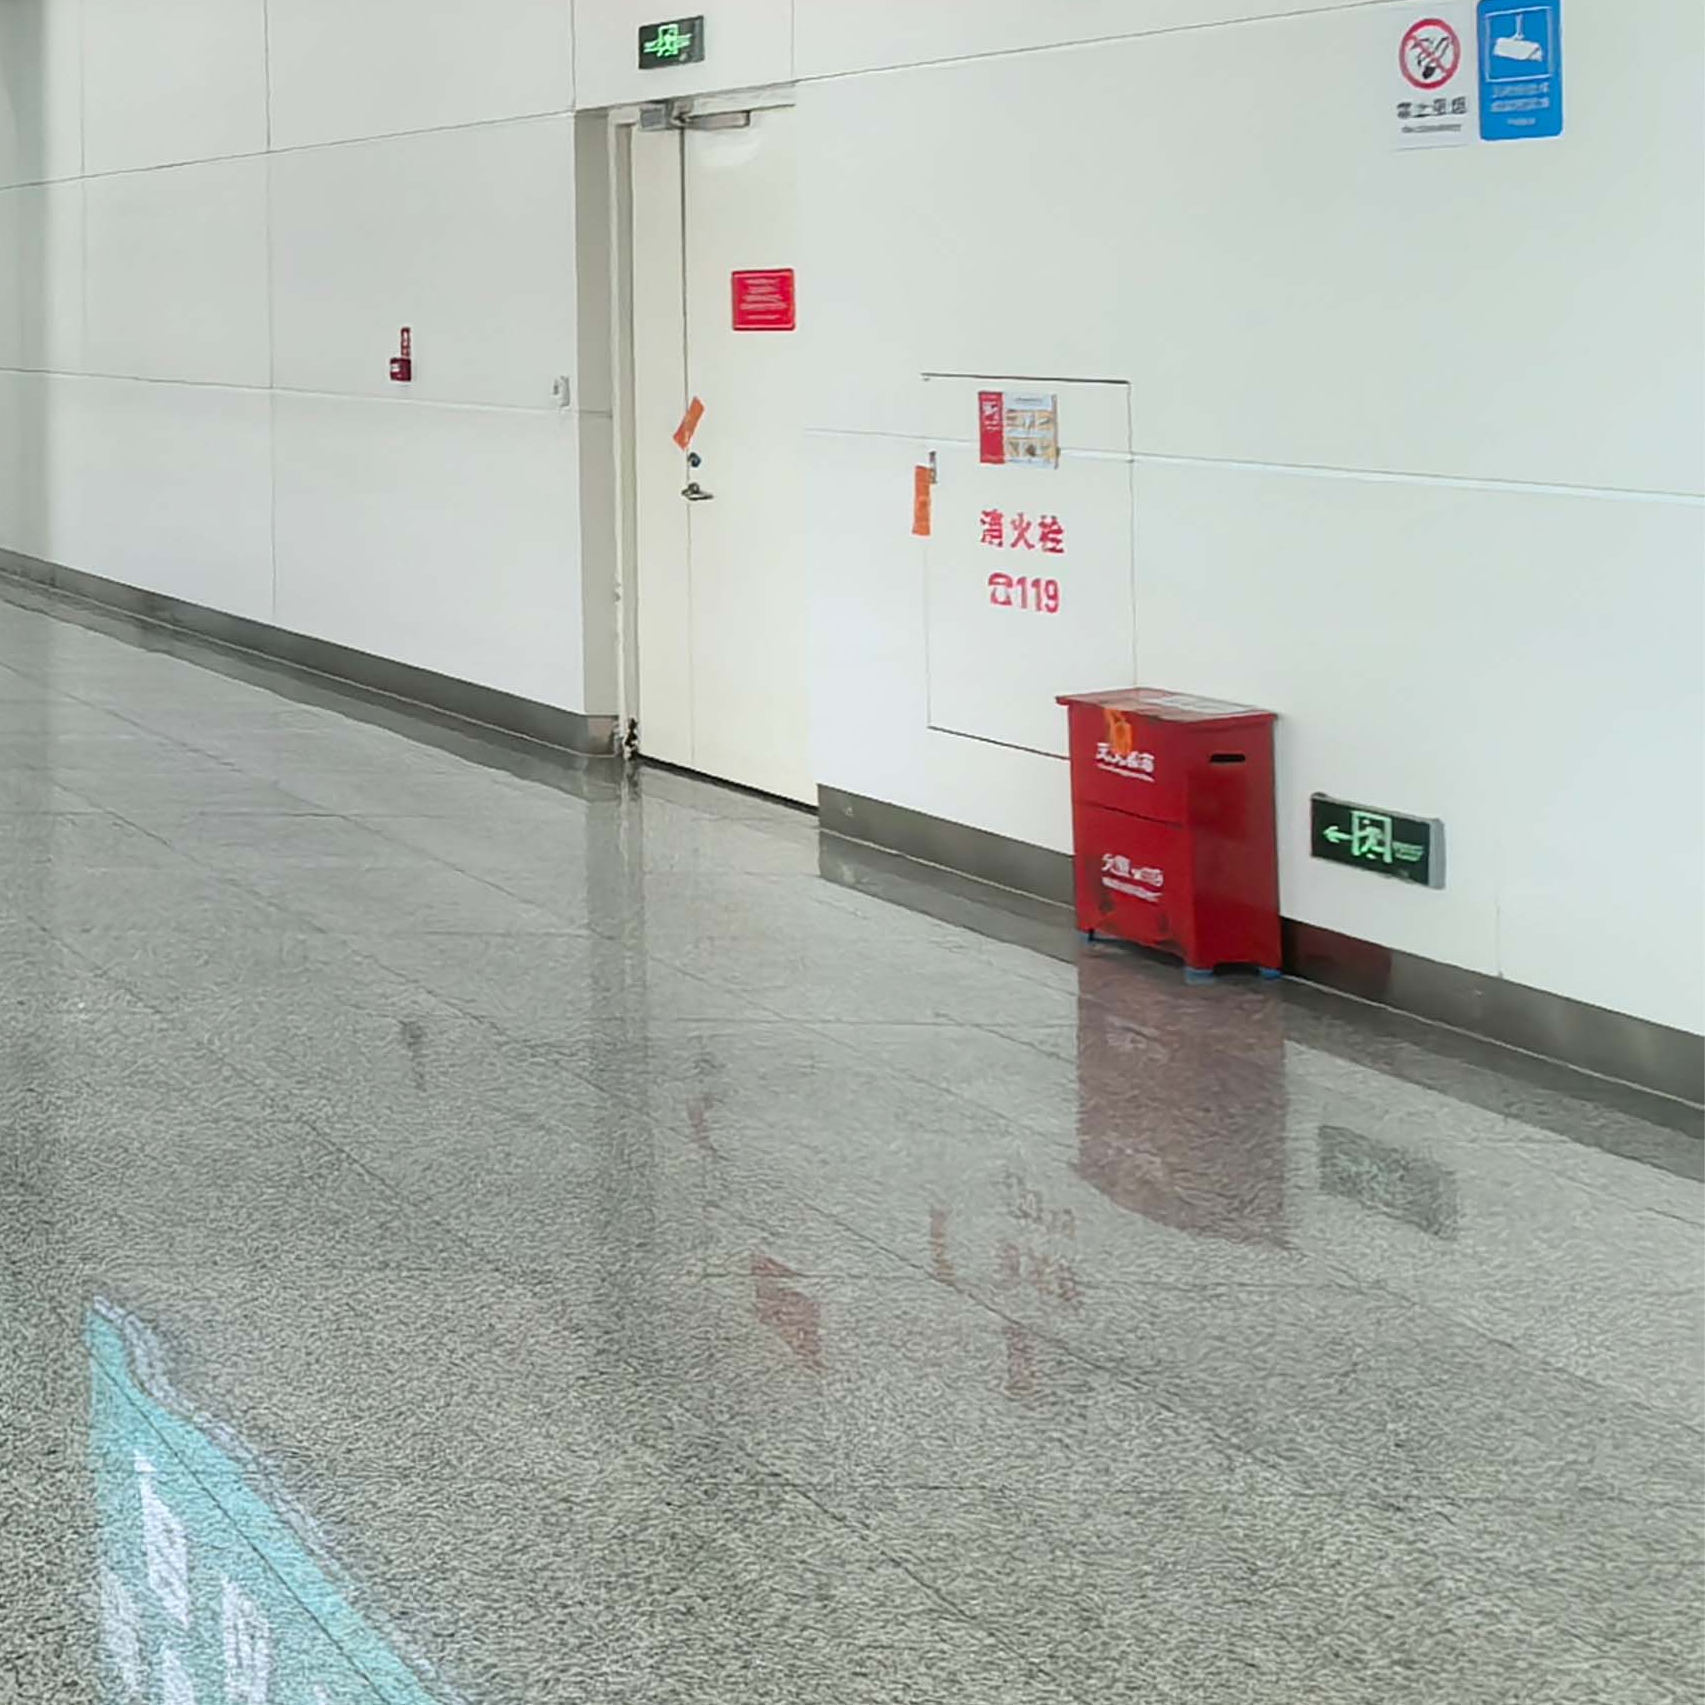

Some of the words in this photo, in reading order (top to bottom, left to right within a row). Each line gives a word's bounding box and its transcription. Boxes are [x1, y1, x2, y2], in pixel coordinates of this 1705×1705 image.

[979, 508, 1065, 554] 消火栓
[1016, 576, 1060, 614] 119
